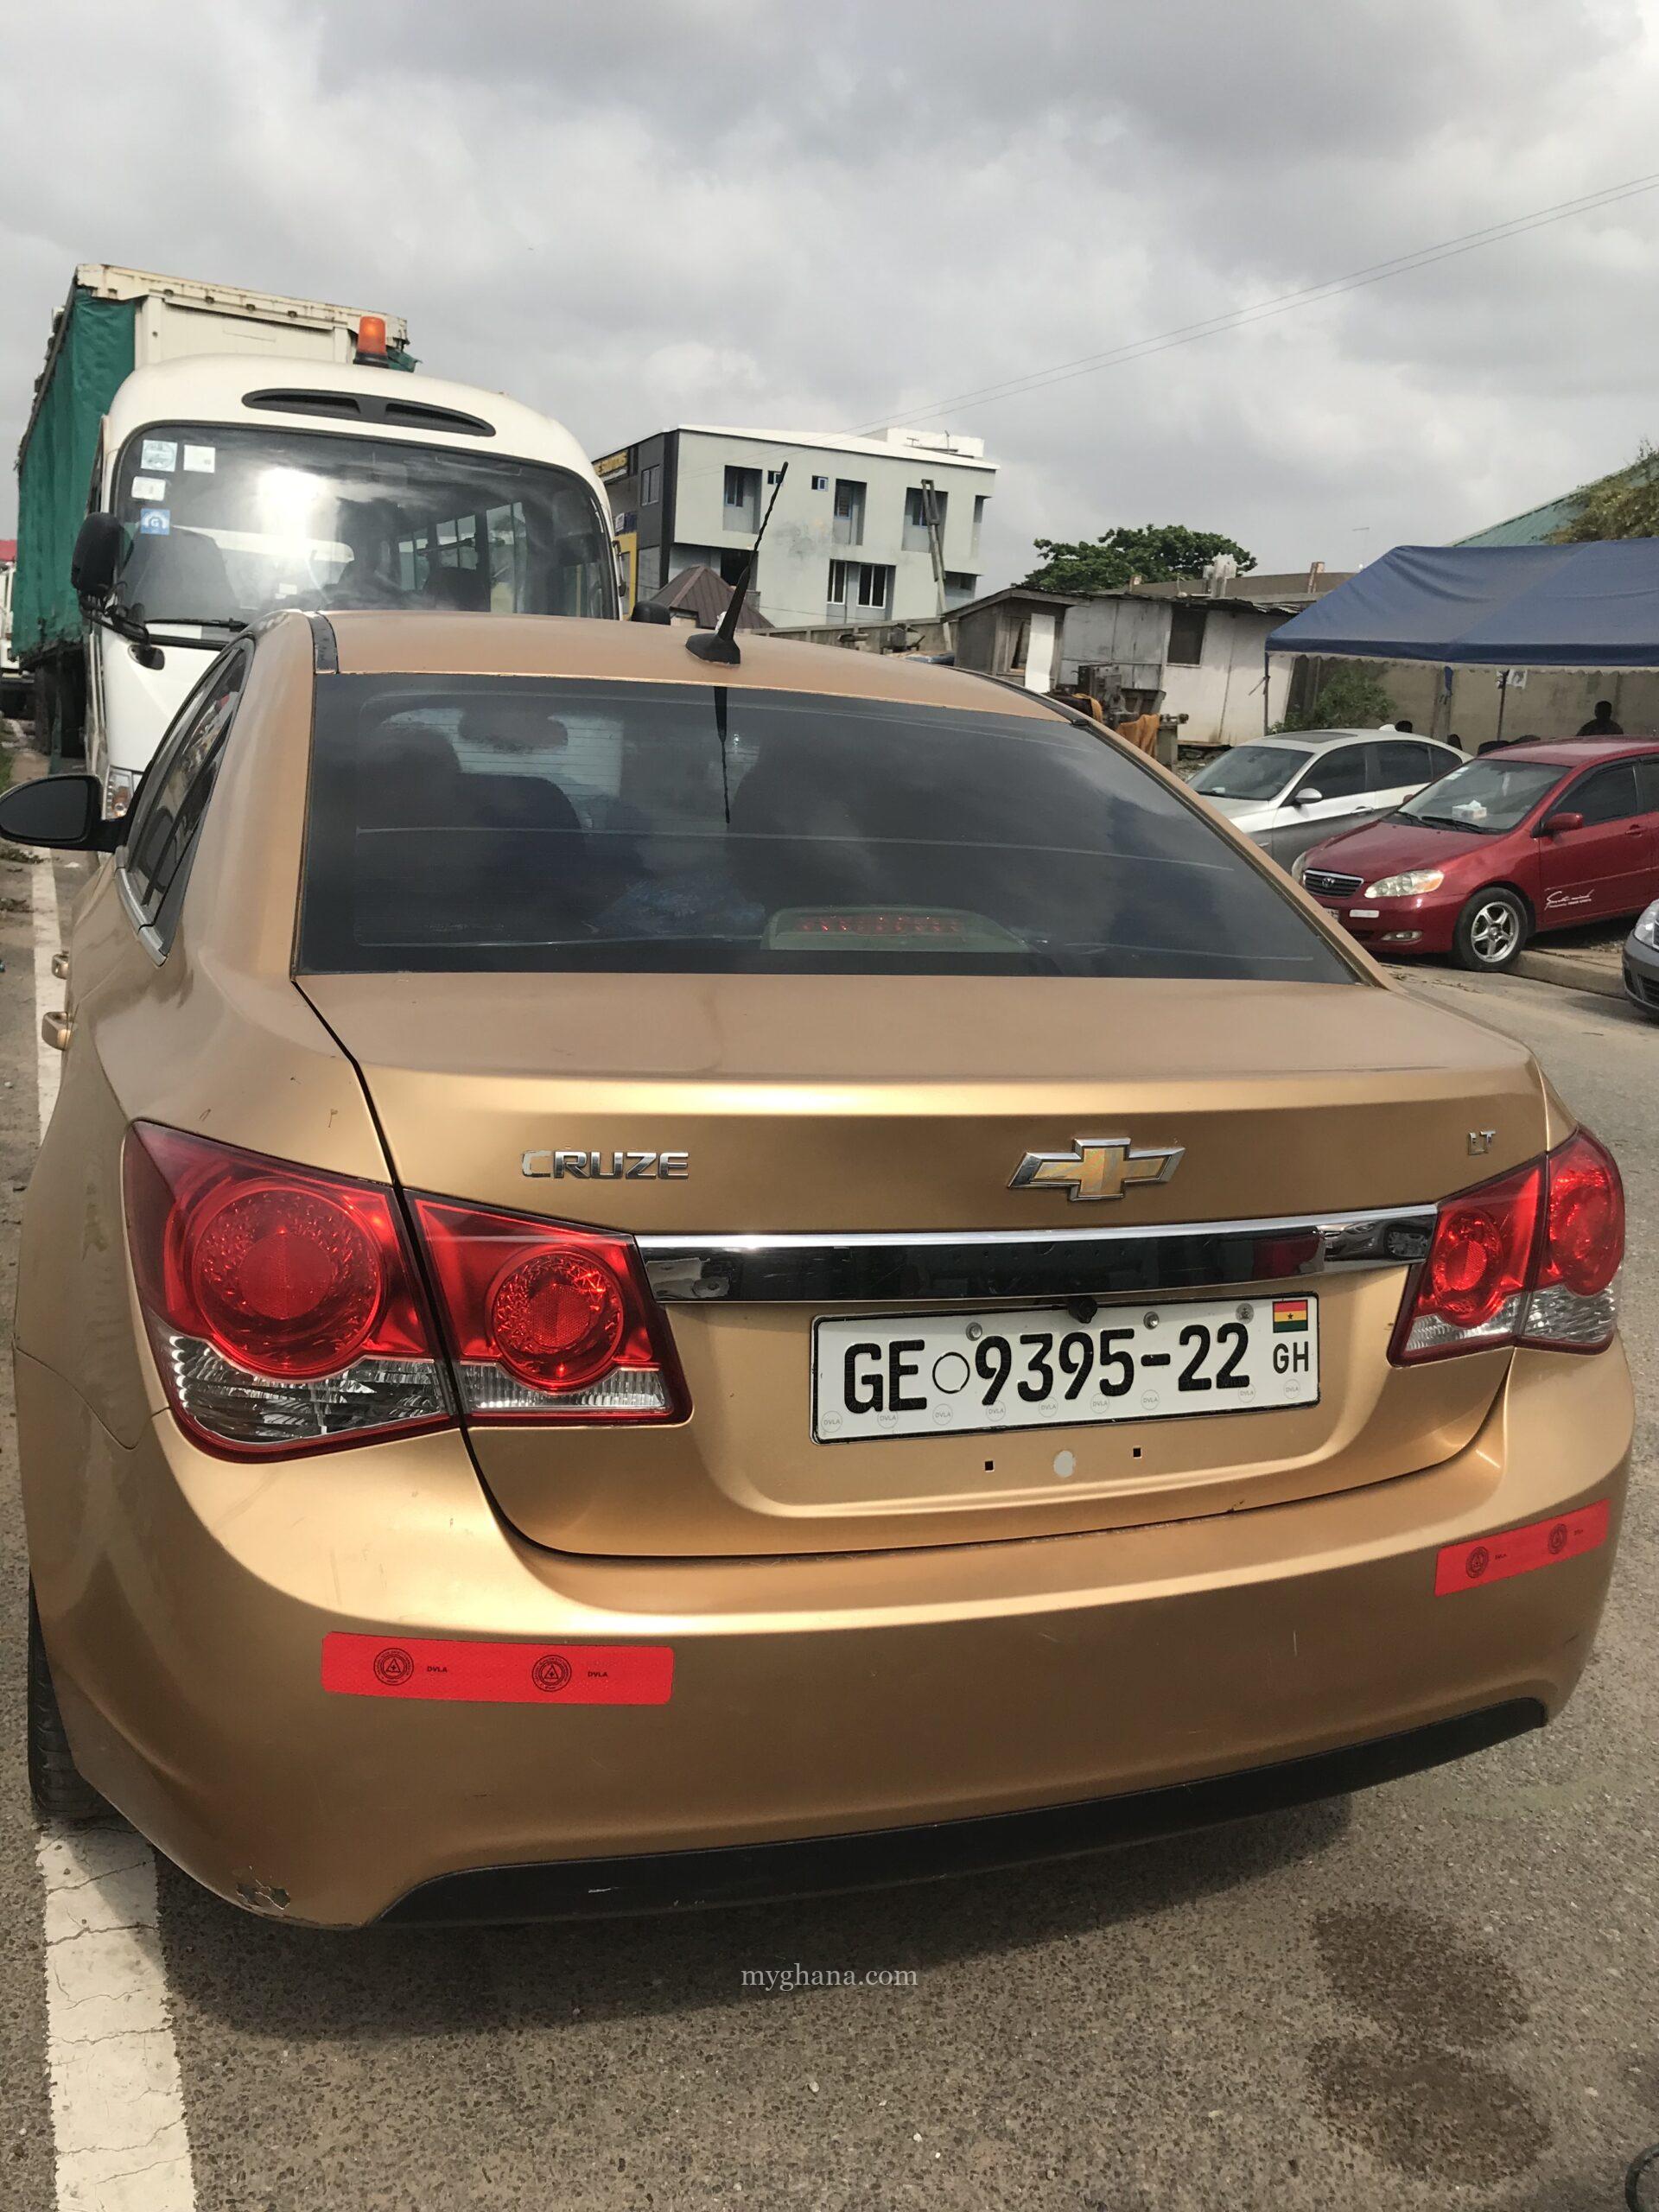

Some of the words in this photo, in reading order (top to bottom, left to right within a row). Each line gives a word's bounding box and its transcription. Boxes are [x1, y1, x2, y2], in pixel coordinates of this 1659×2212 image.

[1468, 1130, 1496, 1155] LT
[522, 1150, 689, 1179] CRUZE
[844, 1339, 927, 1414] GE
[976, 1322, 1250, 1405] 9395-22
[1273, 1341, 1309, 1374] GH
